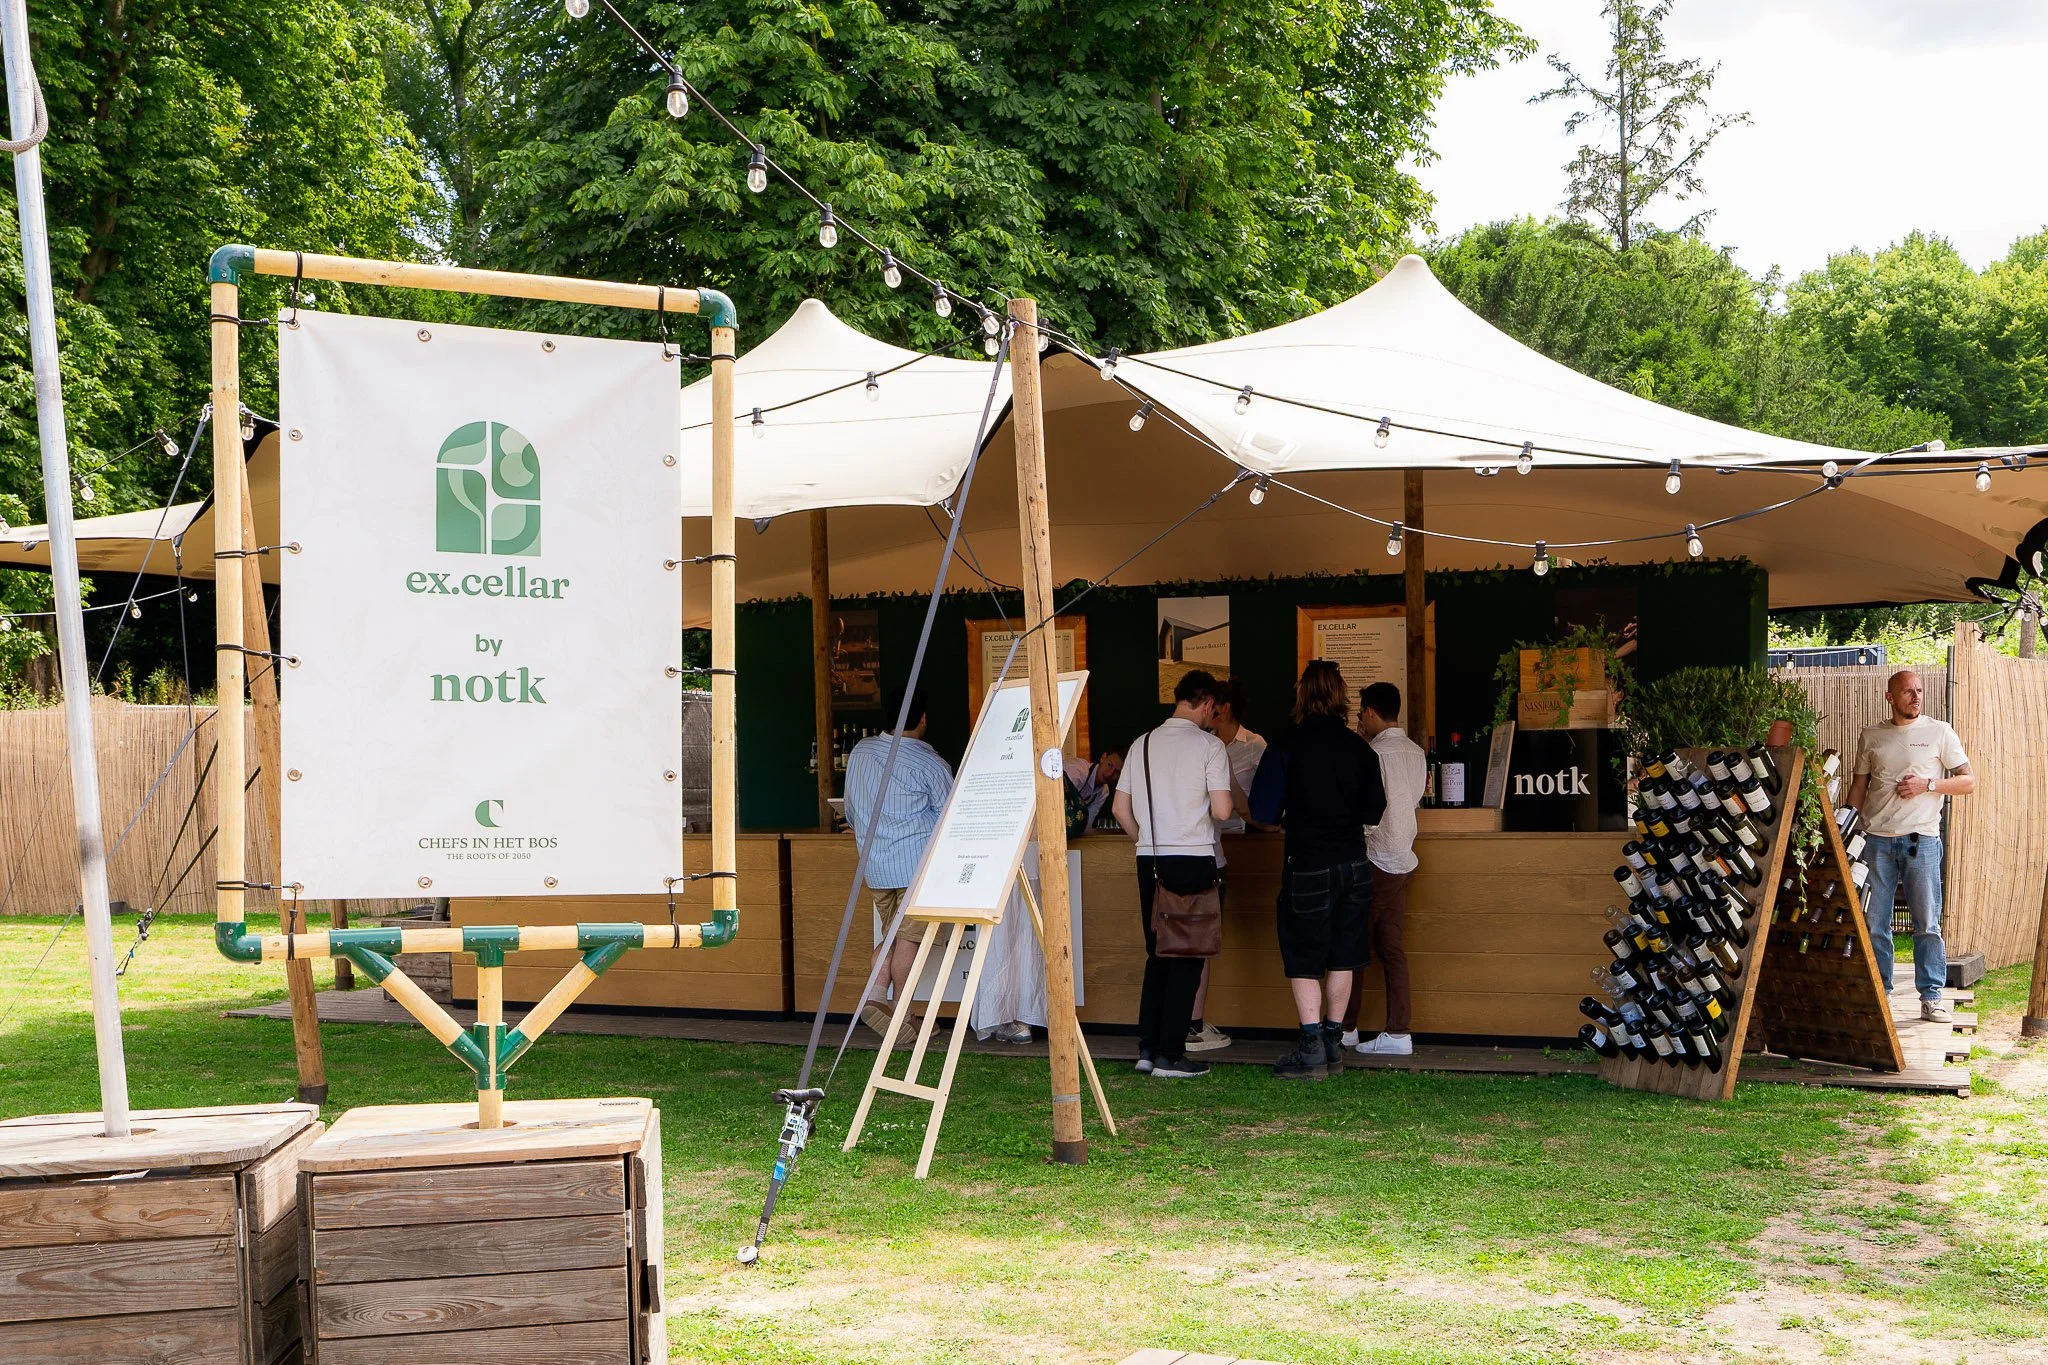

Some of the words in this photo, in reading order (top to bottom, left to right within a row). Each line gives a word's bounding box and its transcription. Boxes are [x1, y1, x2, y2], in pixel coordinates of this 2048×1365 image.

[406, 566, 570, 599] ex.cellar
[1317, 623, 1357, 631] EX.CELLAR
[475, 634, 503, 657] by
[430, 667, 547, 704] notk
[1514, 766, 1590, 795] notk
[418, 838, 468, 849] CHEFS
[472, 838, 489, 849] IN
[494, 838, 525, 849] HET
[529, 838, 558, 849] BOS
